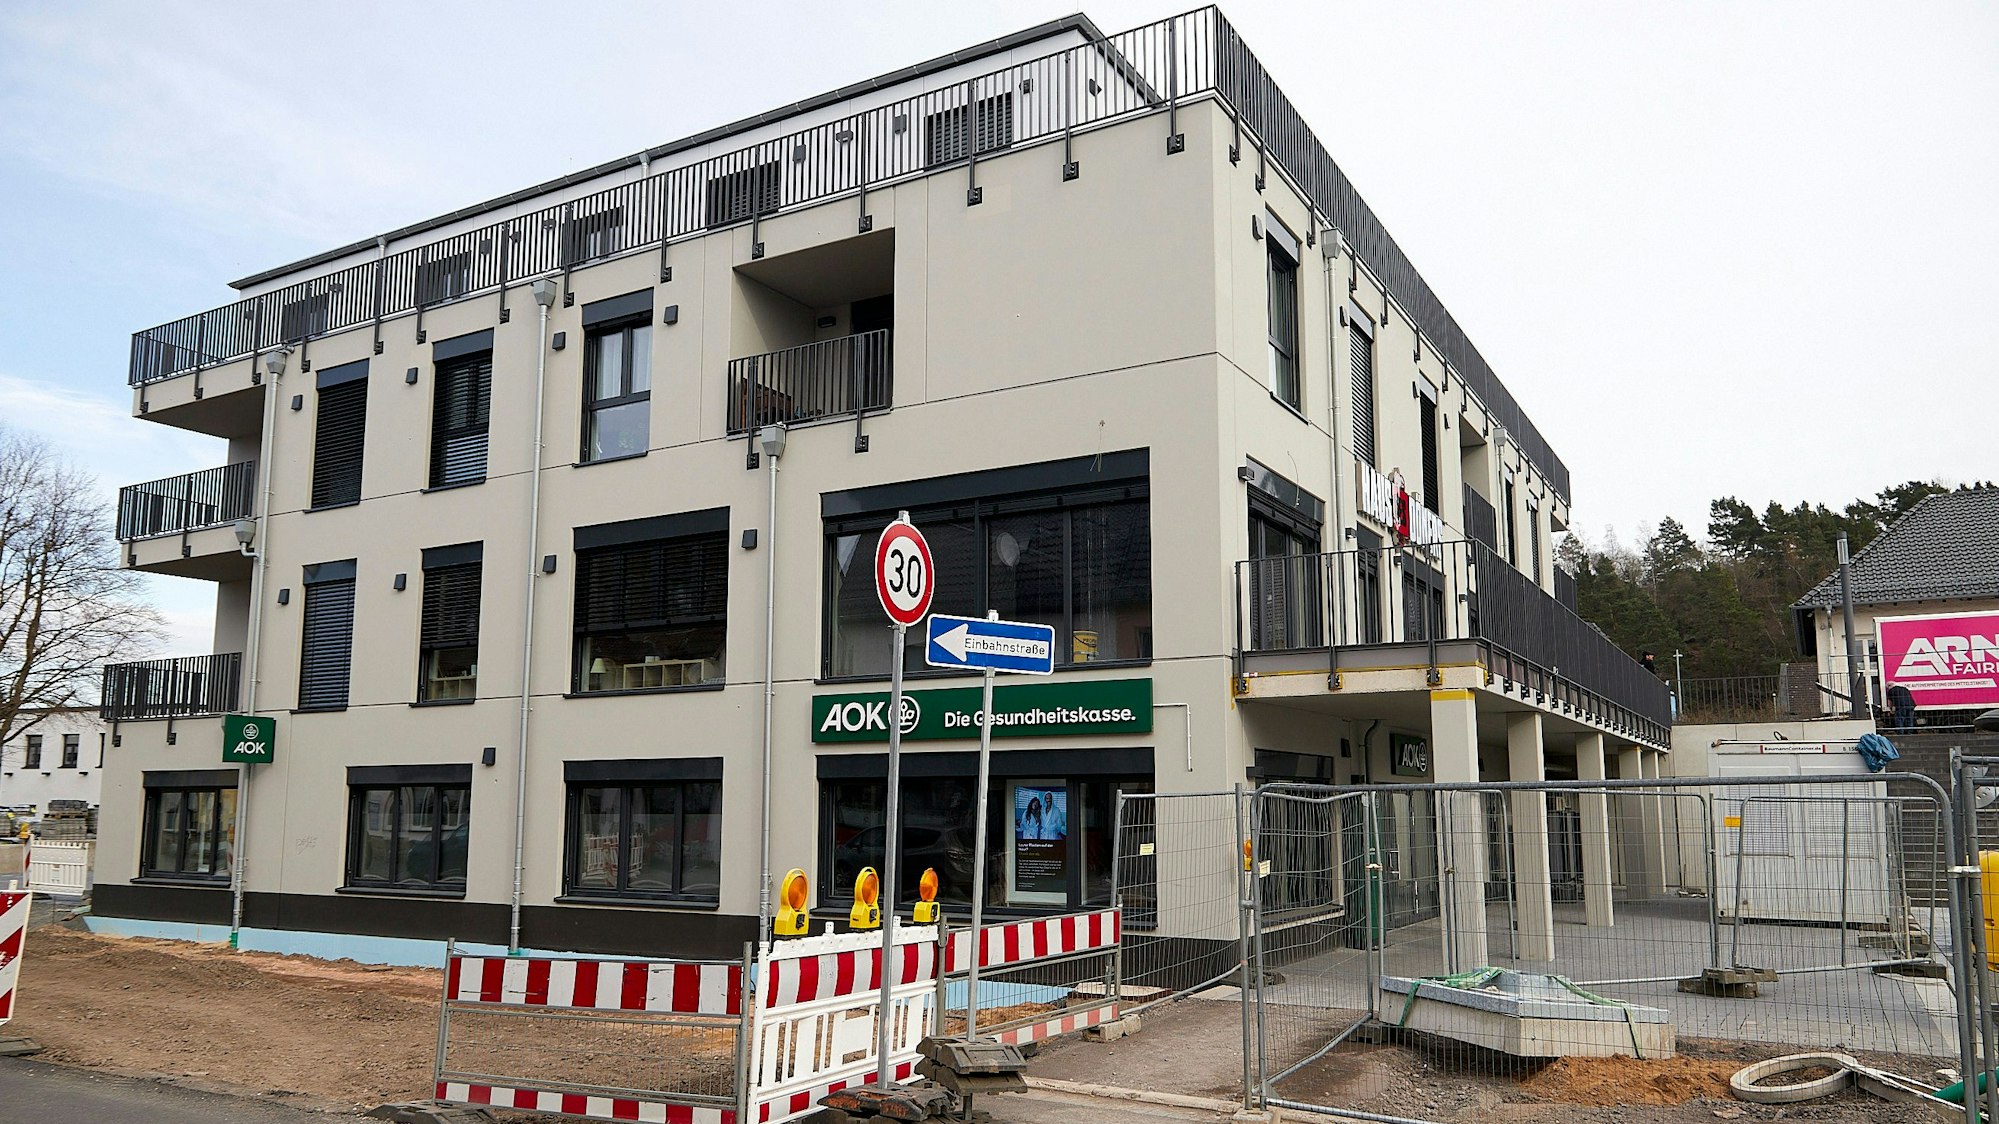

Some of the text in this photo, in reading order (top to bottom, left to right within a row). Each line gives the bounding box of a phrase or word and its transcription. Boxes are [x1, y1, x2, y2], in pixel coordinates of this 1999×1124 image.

[1361, 461, 1393, 528] HAUS
[889, 549, 922, 598] 30
[964, 637, 1046, 656] Einbahnstraße
[820, 701, 1136, 732] AOK Die Gesundheitskasse.
[233, 741, 266, 755] AOK
[1402, 743, 1420, 768] AOK
